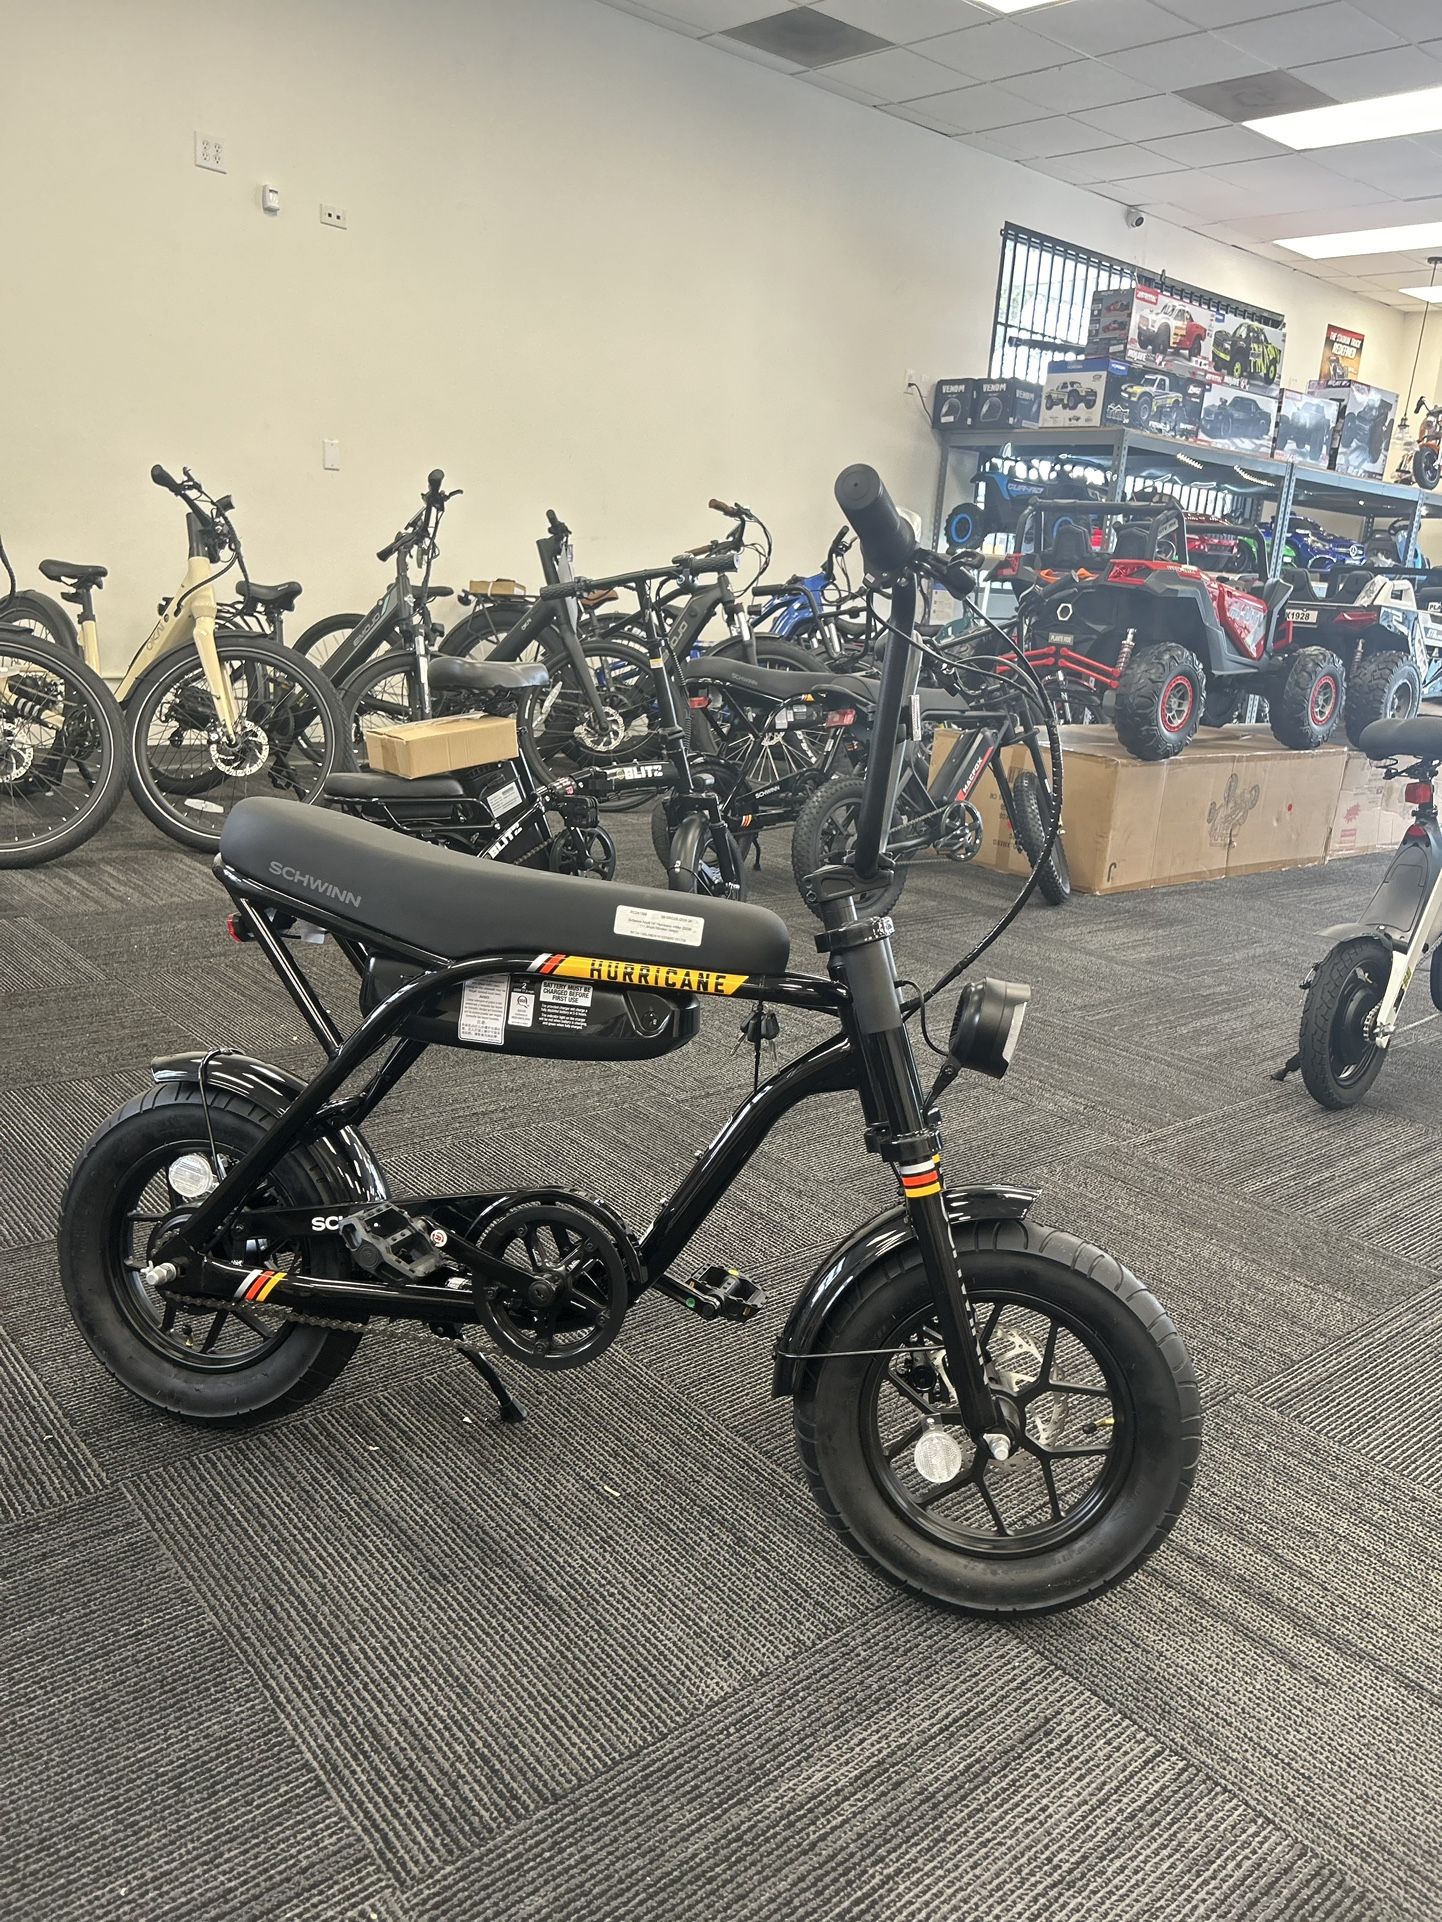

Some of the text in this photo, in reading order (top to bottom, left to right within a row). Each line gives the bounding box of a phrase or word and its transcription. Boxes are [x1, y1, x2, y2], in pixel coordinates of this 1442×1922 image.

[942, 384, 965, 393] VENOM
[982, 383, 1007, 393] VENOM
[1015, 389, 1035, 401] VENOM
[623, 765, 663, 780] BLITZ
[962, 757, 983, 793] MACFOX
[488, 822, 523, 859] BLITZ
[268, 861, 362, 908] SCHWINN
[590, 959, 727, 993] HURRICANE
[543, 982, 567, 990] BATTERY
[543, 988, 589, 998] CHARGED BEFORE
[311, 1216, 343, 1232] SC
